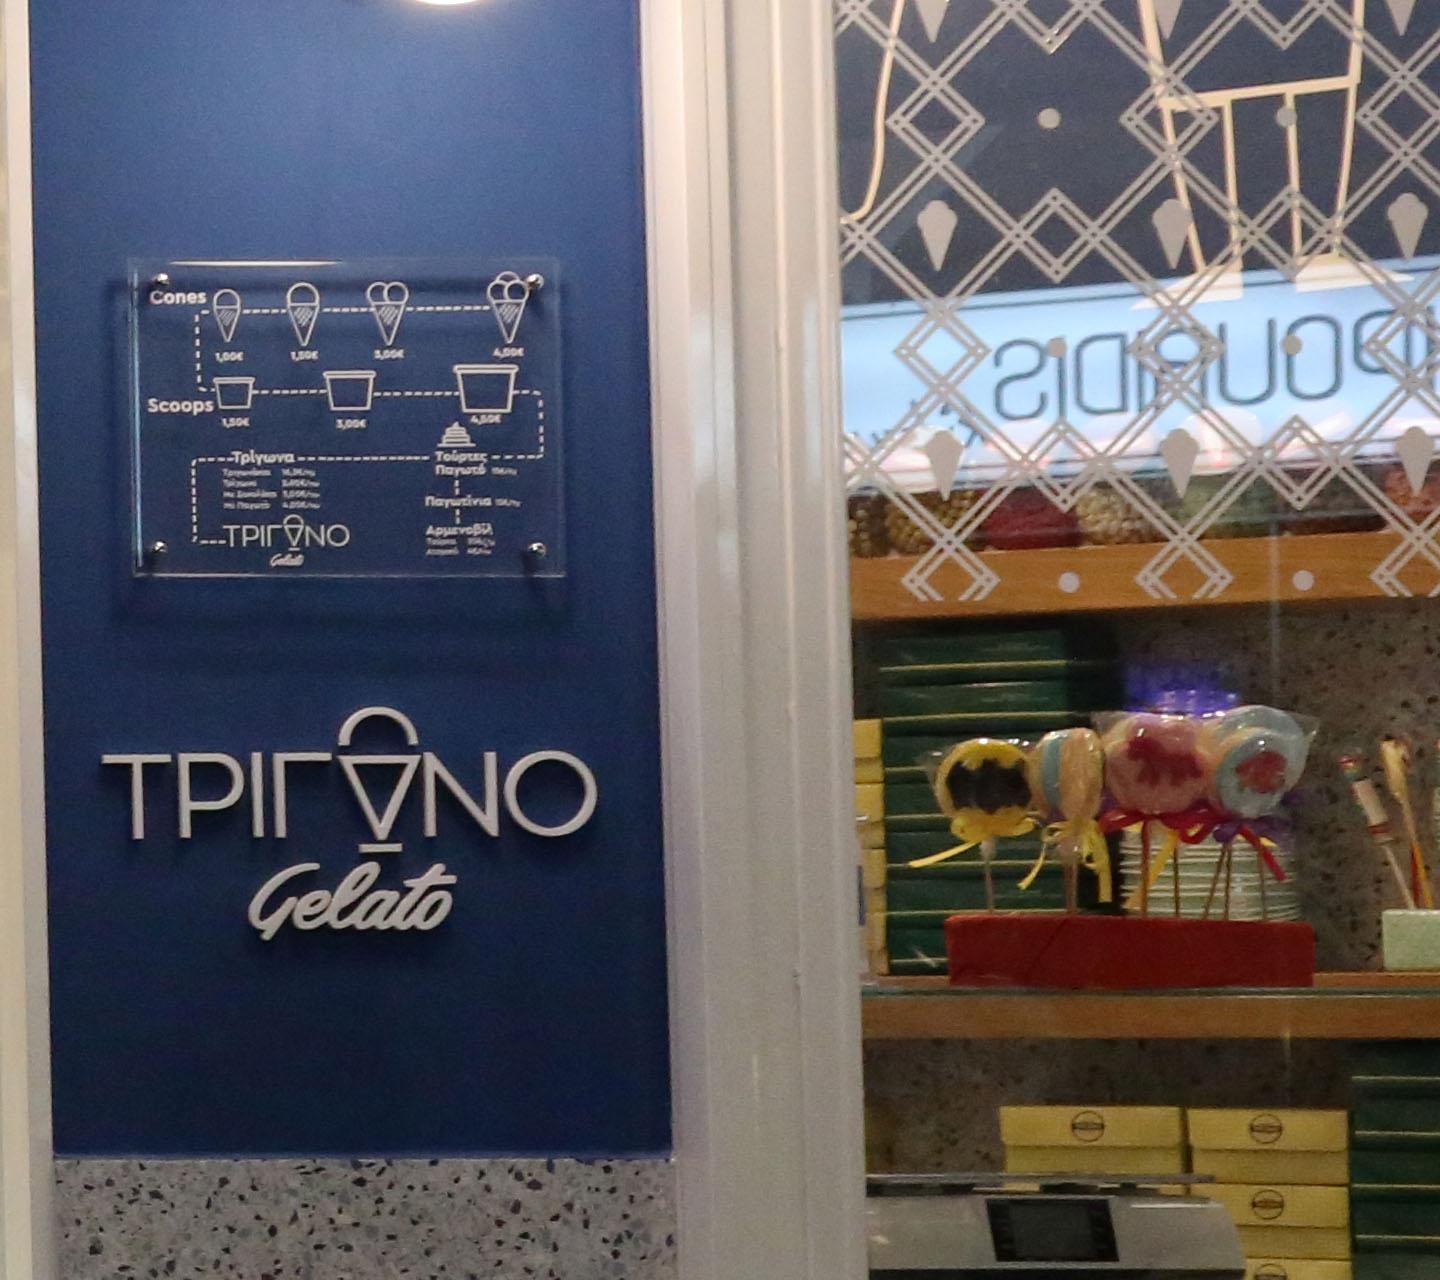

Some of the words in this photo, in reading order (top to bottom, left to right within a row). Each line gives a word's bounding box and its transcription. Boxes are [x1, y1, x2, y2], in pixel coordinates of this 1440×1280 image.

[149, 290, 208, 305] Cones
[147, 397, 215, 416] Scoops
[247, 862, 458, 942] Gelato
